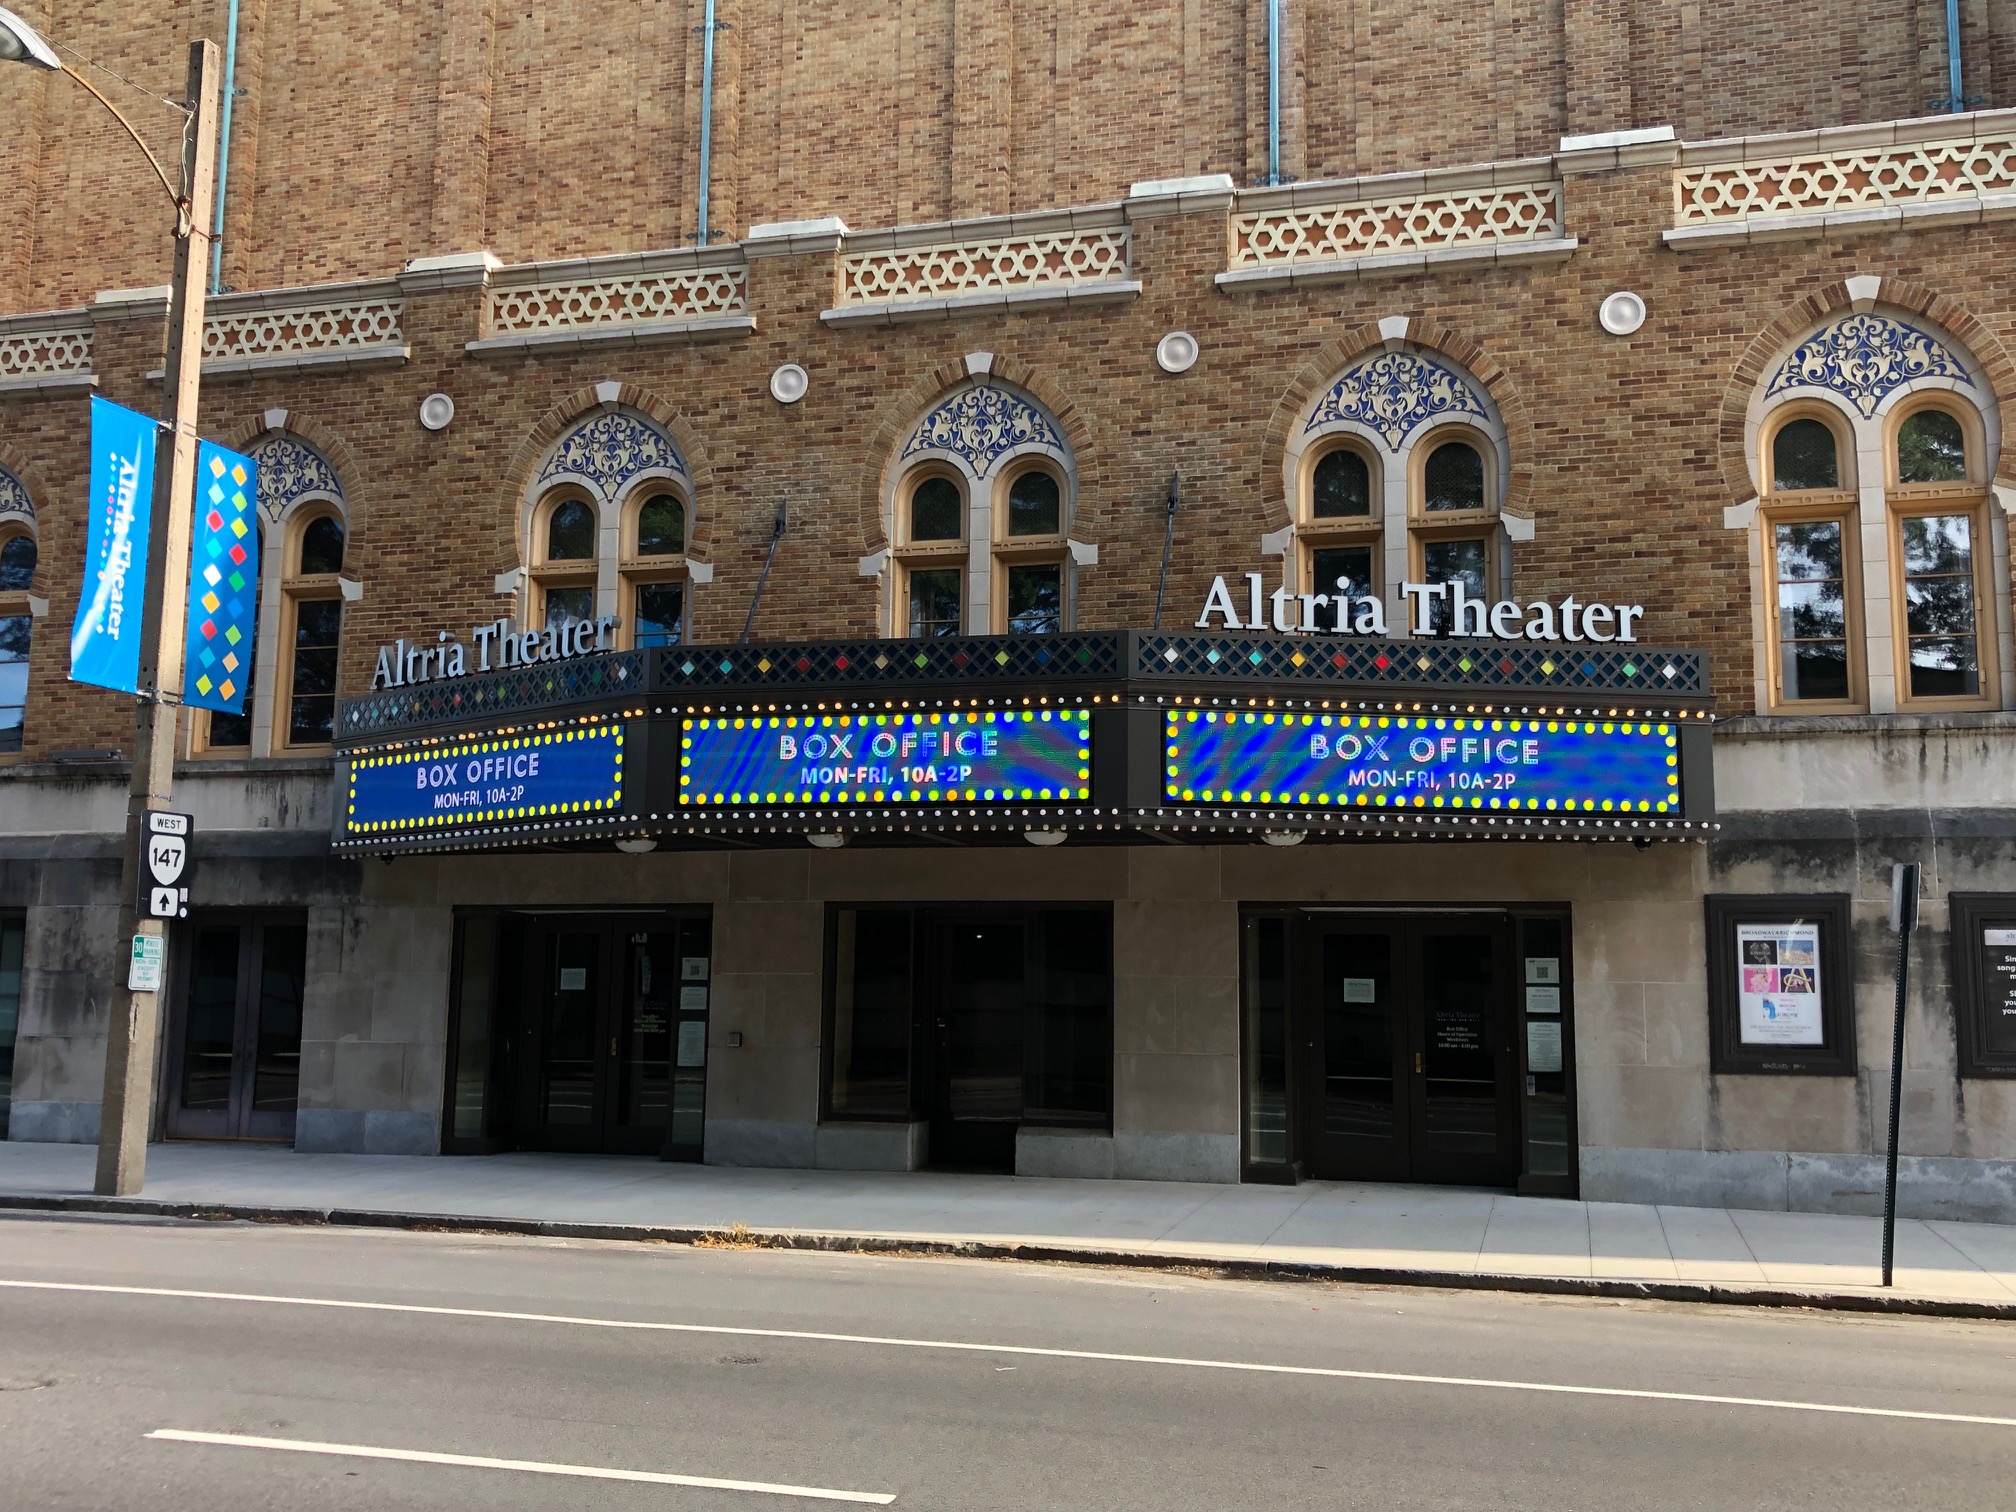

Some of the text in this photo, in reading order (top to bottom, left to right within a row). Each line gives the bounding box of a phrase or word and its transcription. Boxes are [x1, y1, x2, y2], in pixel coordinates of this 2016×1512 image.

[108, 455, 137, 641] Altria Theater
[1195, 573, 1644, 642] Altria Theater
[370, 616, 621, 690] Altria Theater
[780, 730, 998, 760] BOX OFFICE
[1310, 733, 1539, 765] BOX OFFICE
[416, 753, 539, 790] BOX OFFICE
[800, 765, 972, 785] MON-FRI, 10A-2P
[1348, 769, 1516, 791] MON-FRI, 10A-2P
[434, 786, 524, 810] MON-FRI, 10A-2P
[157, 818, 181, 829] WEST
[154, 847, 181, 867] 147
[134, 942, 142, 953] 30
